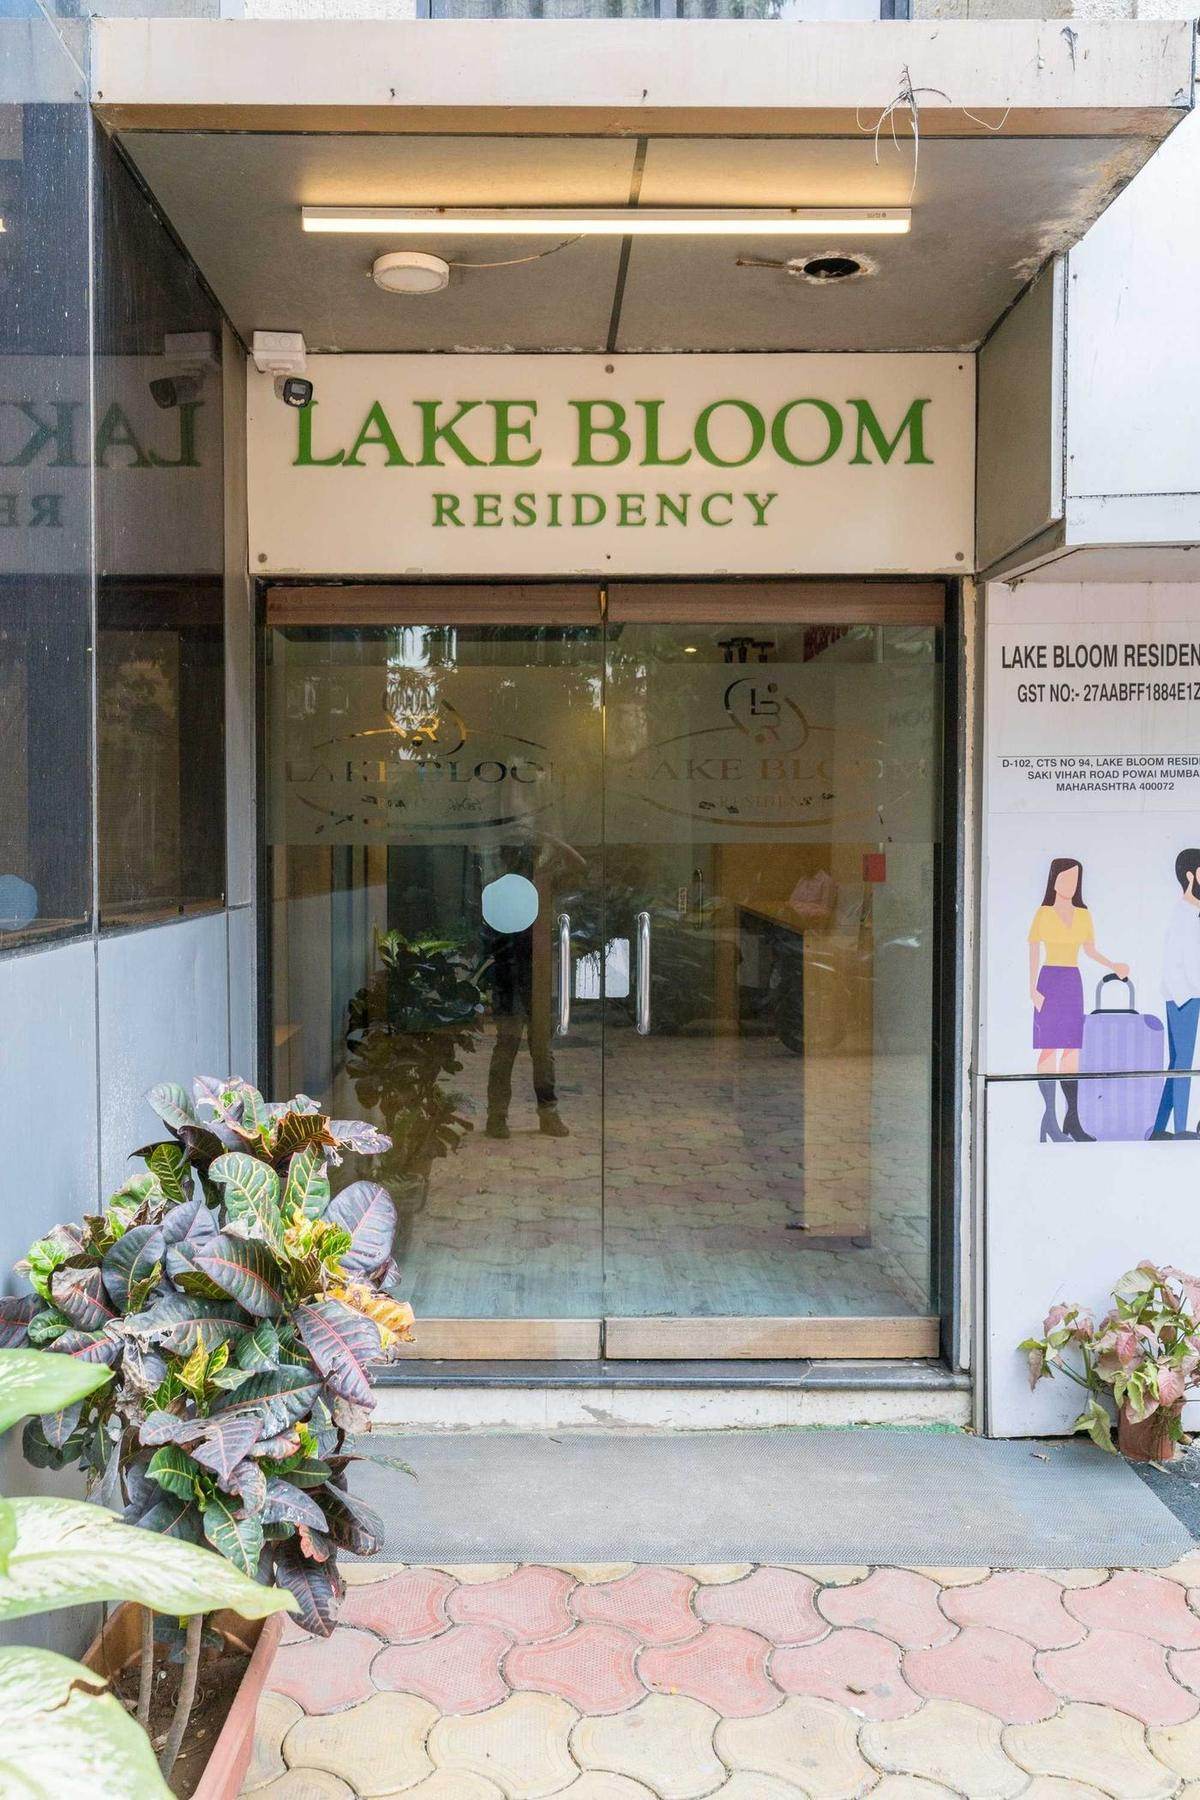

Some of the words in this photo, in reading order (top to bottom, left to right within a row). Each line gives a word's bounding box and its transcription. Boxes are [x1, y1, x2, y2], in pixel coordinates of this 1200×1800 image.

[292, 399, 542, 467] LAKE
[568, 398, 934, 468] BLOOM
[431, 493, 778, 527] RESIDENCY
[1001, 645, 1047, 669] LAKE
[1053, 644, 1118, 669] BLOOM
[1124, 643, 1200, 668] RESIDEN
[1017, 684, 1045, 703] GST
[1050, 683, 1080, 702] NO:-
[1083, 682, 1200, 702] 27AABFF1884E1Z
[1002, 759, 1033, 769] D-102,
[1036, 758, 1057, 768] CTS
[1060, 758, 1076, 768] NO
[1078, 758, 1094, 769] 94,
[1096, 758, 1123, 767] LAKE
[1126, 757, 1164, 767] BLOOM
[1167, 757, 1200, 766] RESID
[1027, 771, 1052, 780] SAKI
[1055, 770, 1086, 780] VIHAR
[1089, 770, 1120, 779] ROAD
[1122, 769, 1157, 779] POWAI
[1160, 769, 1200, 778] MUMBA
[1056, 782, 1137, 792] MAHARASHTRA
[1139, 782, 1175, 791] 400072
